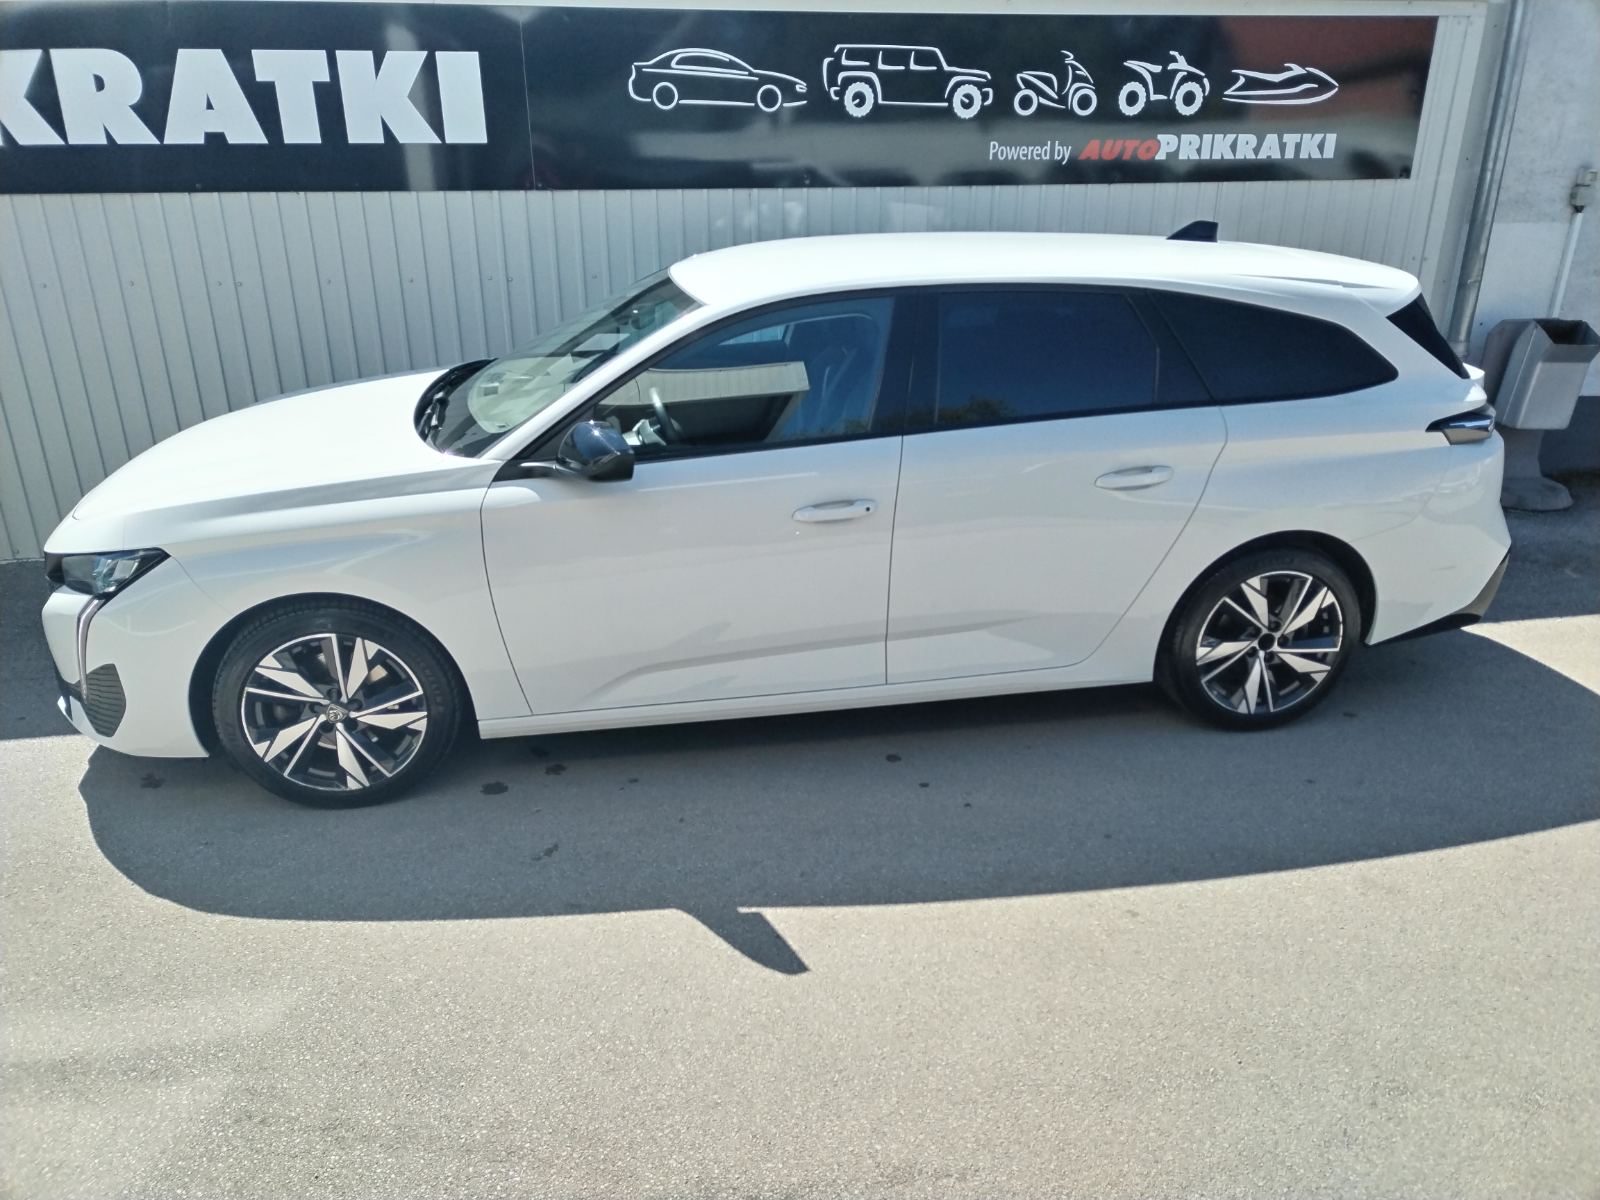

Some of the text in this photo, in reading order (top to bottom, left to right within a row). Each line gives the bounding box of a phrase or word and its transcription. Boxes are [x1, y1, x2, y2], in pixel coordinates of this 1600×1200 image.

[989, 133, 1337, 165] Powered by AUTOPRIKRATKI
